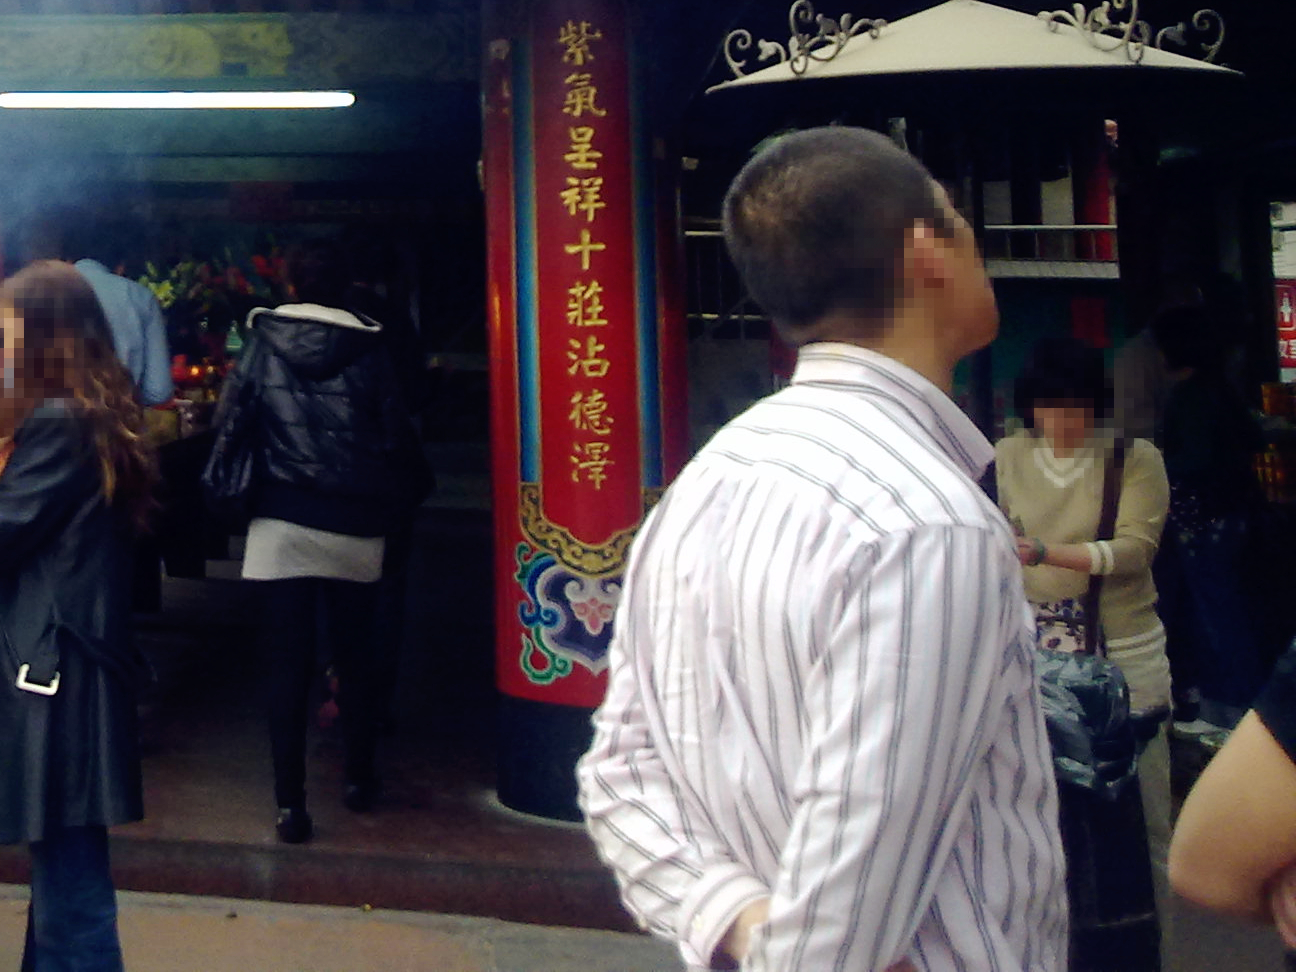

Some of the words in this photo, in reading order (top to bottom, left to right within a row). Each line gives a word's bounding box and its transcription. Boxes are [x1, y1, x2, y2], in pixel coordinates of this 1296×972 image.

[558, 19, 615, 490] 紫氣呈祥十莊沾德澤
